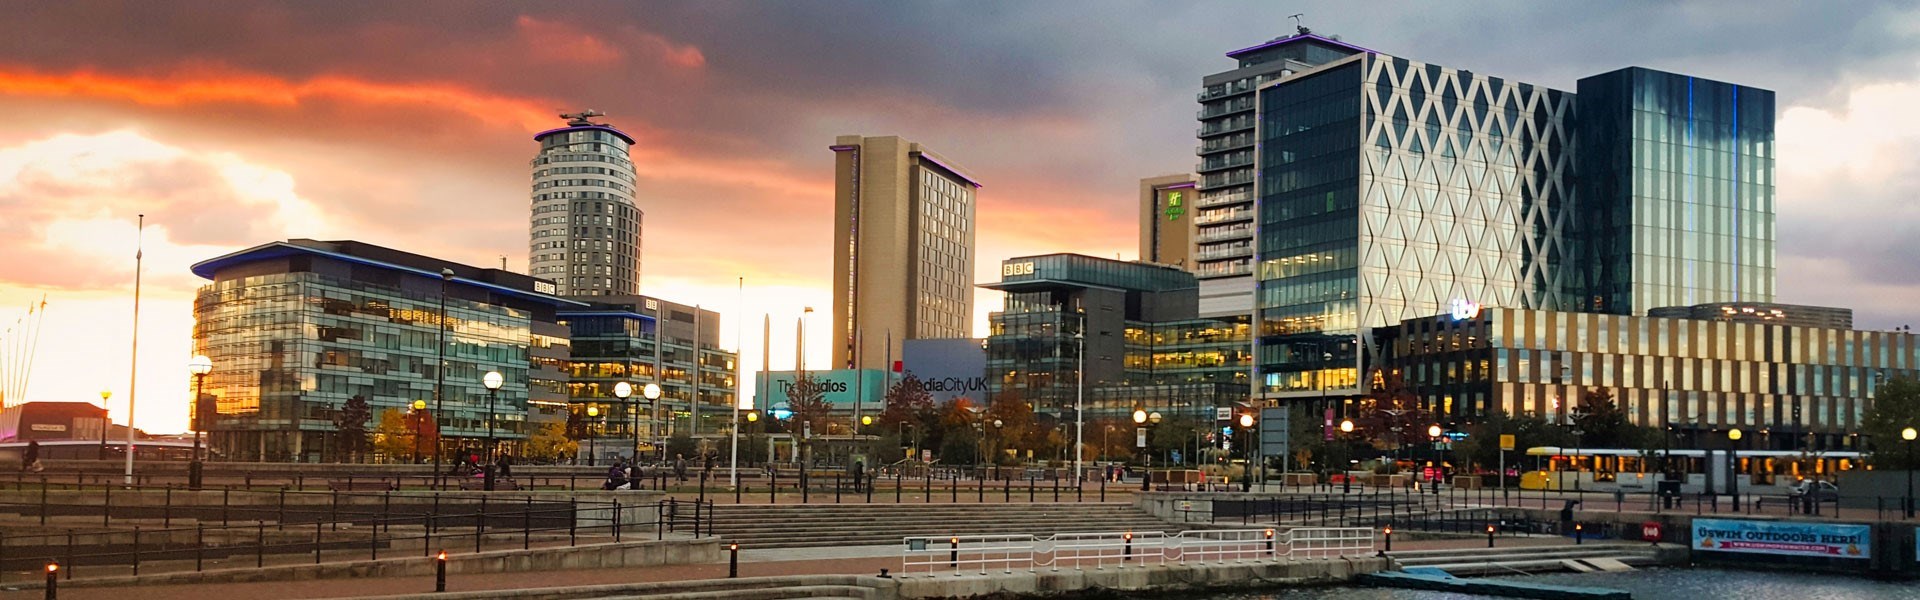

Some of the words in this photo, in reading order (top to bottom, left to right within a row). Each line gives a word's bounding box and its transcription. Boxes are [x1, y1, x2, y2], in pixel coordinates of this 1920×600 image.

[1005, 263, 1033, 275] BBC
[535, 281, 555, 294] BBC
[646, 299, 657, 310] BB
[1452, 299, 1480, 320] itv
[903, 377, 987, 395] diaCityUK
[1746, 531, 1817, 543] OUTDOORS
[1821, 534, 1862, 545] HERE!
